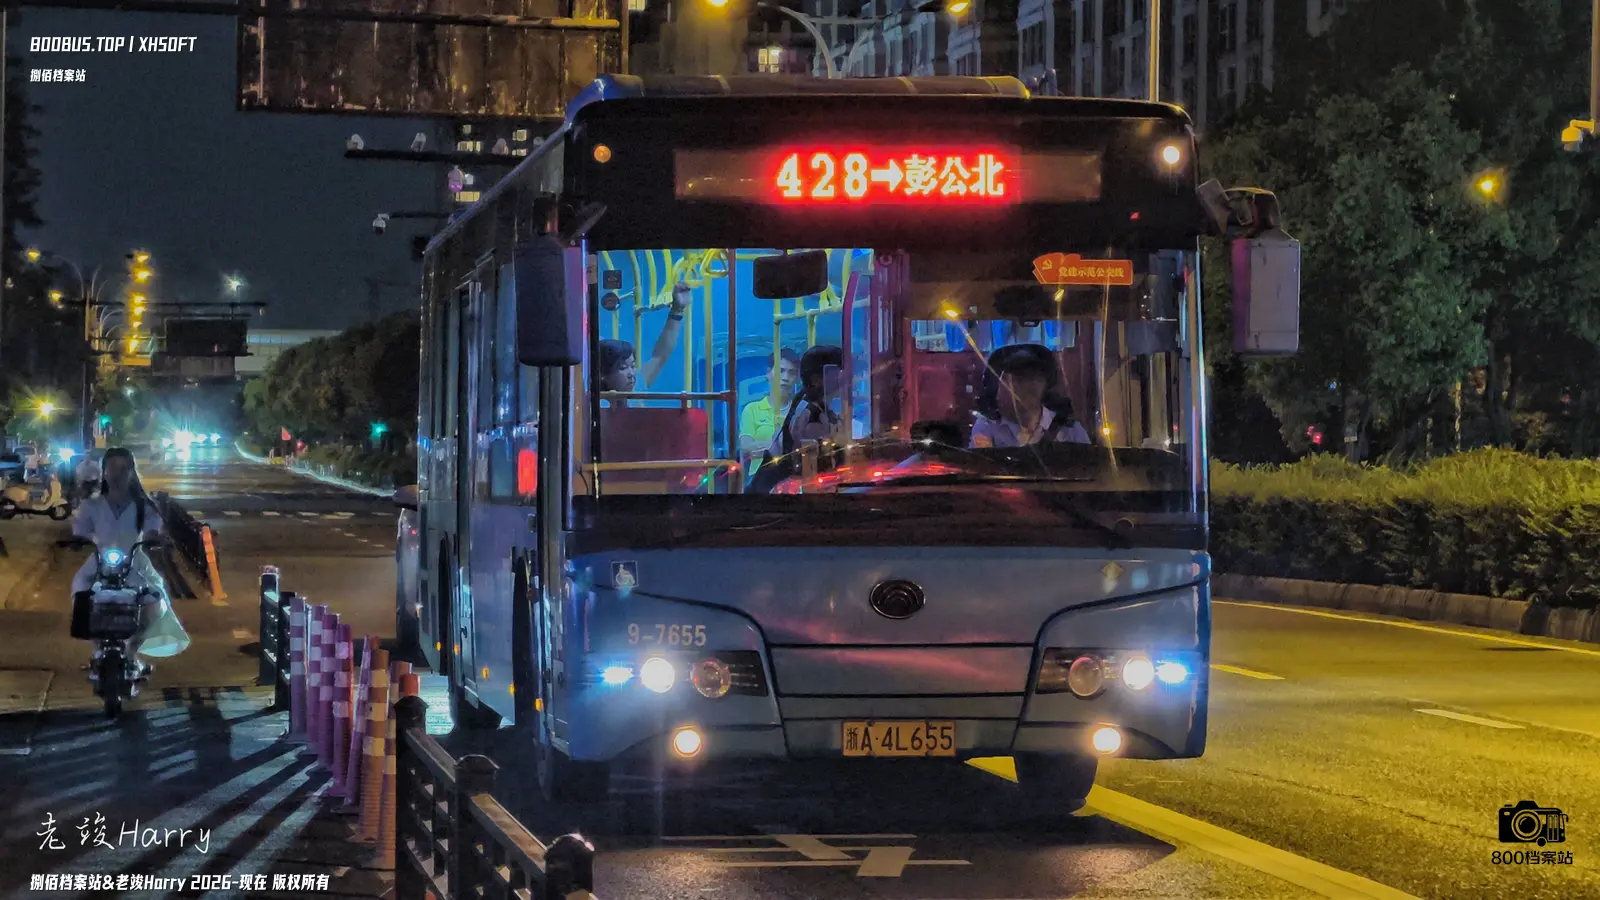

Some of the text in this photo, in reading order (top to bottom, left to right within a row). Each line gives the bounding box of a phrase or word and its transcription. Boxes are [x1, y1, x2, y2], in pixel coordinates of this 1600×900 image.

[777, 153, 1005, 198] 428 彭公北
[627, 623, 707, 647] 9-7655
